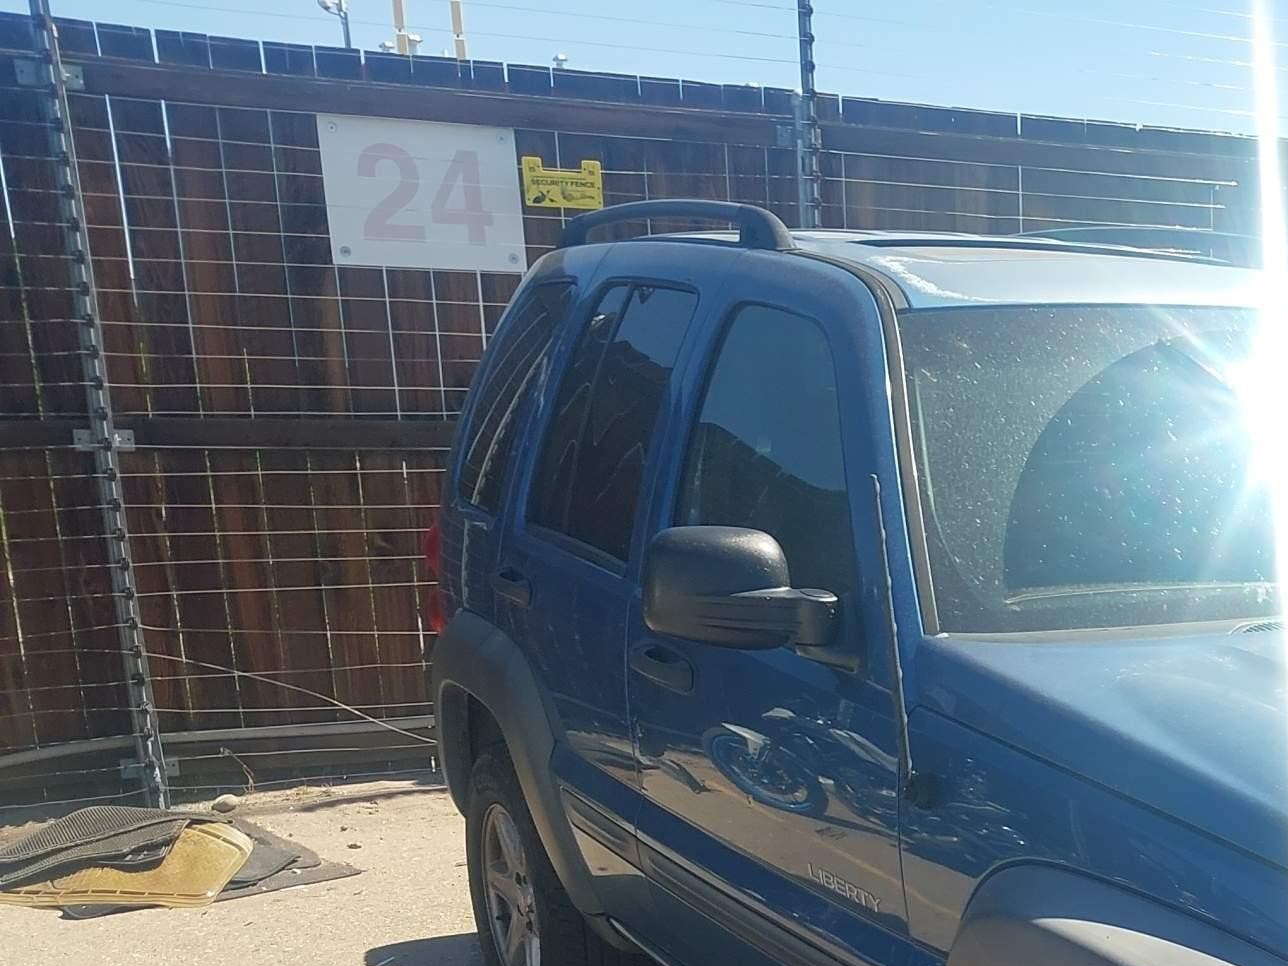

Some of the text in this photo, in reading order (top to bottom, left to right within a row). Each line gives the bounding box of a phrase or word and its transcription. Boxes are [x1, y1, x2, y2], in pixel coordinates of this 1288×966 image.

[357, 142, 494, 246] 24
[531, 178, 596, 189] SECURITY FENCE
[807, 863, 881, 913] LIBERTY
